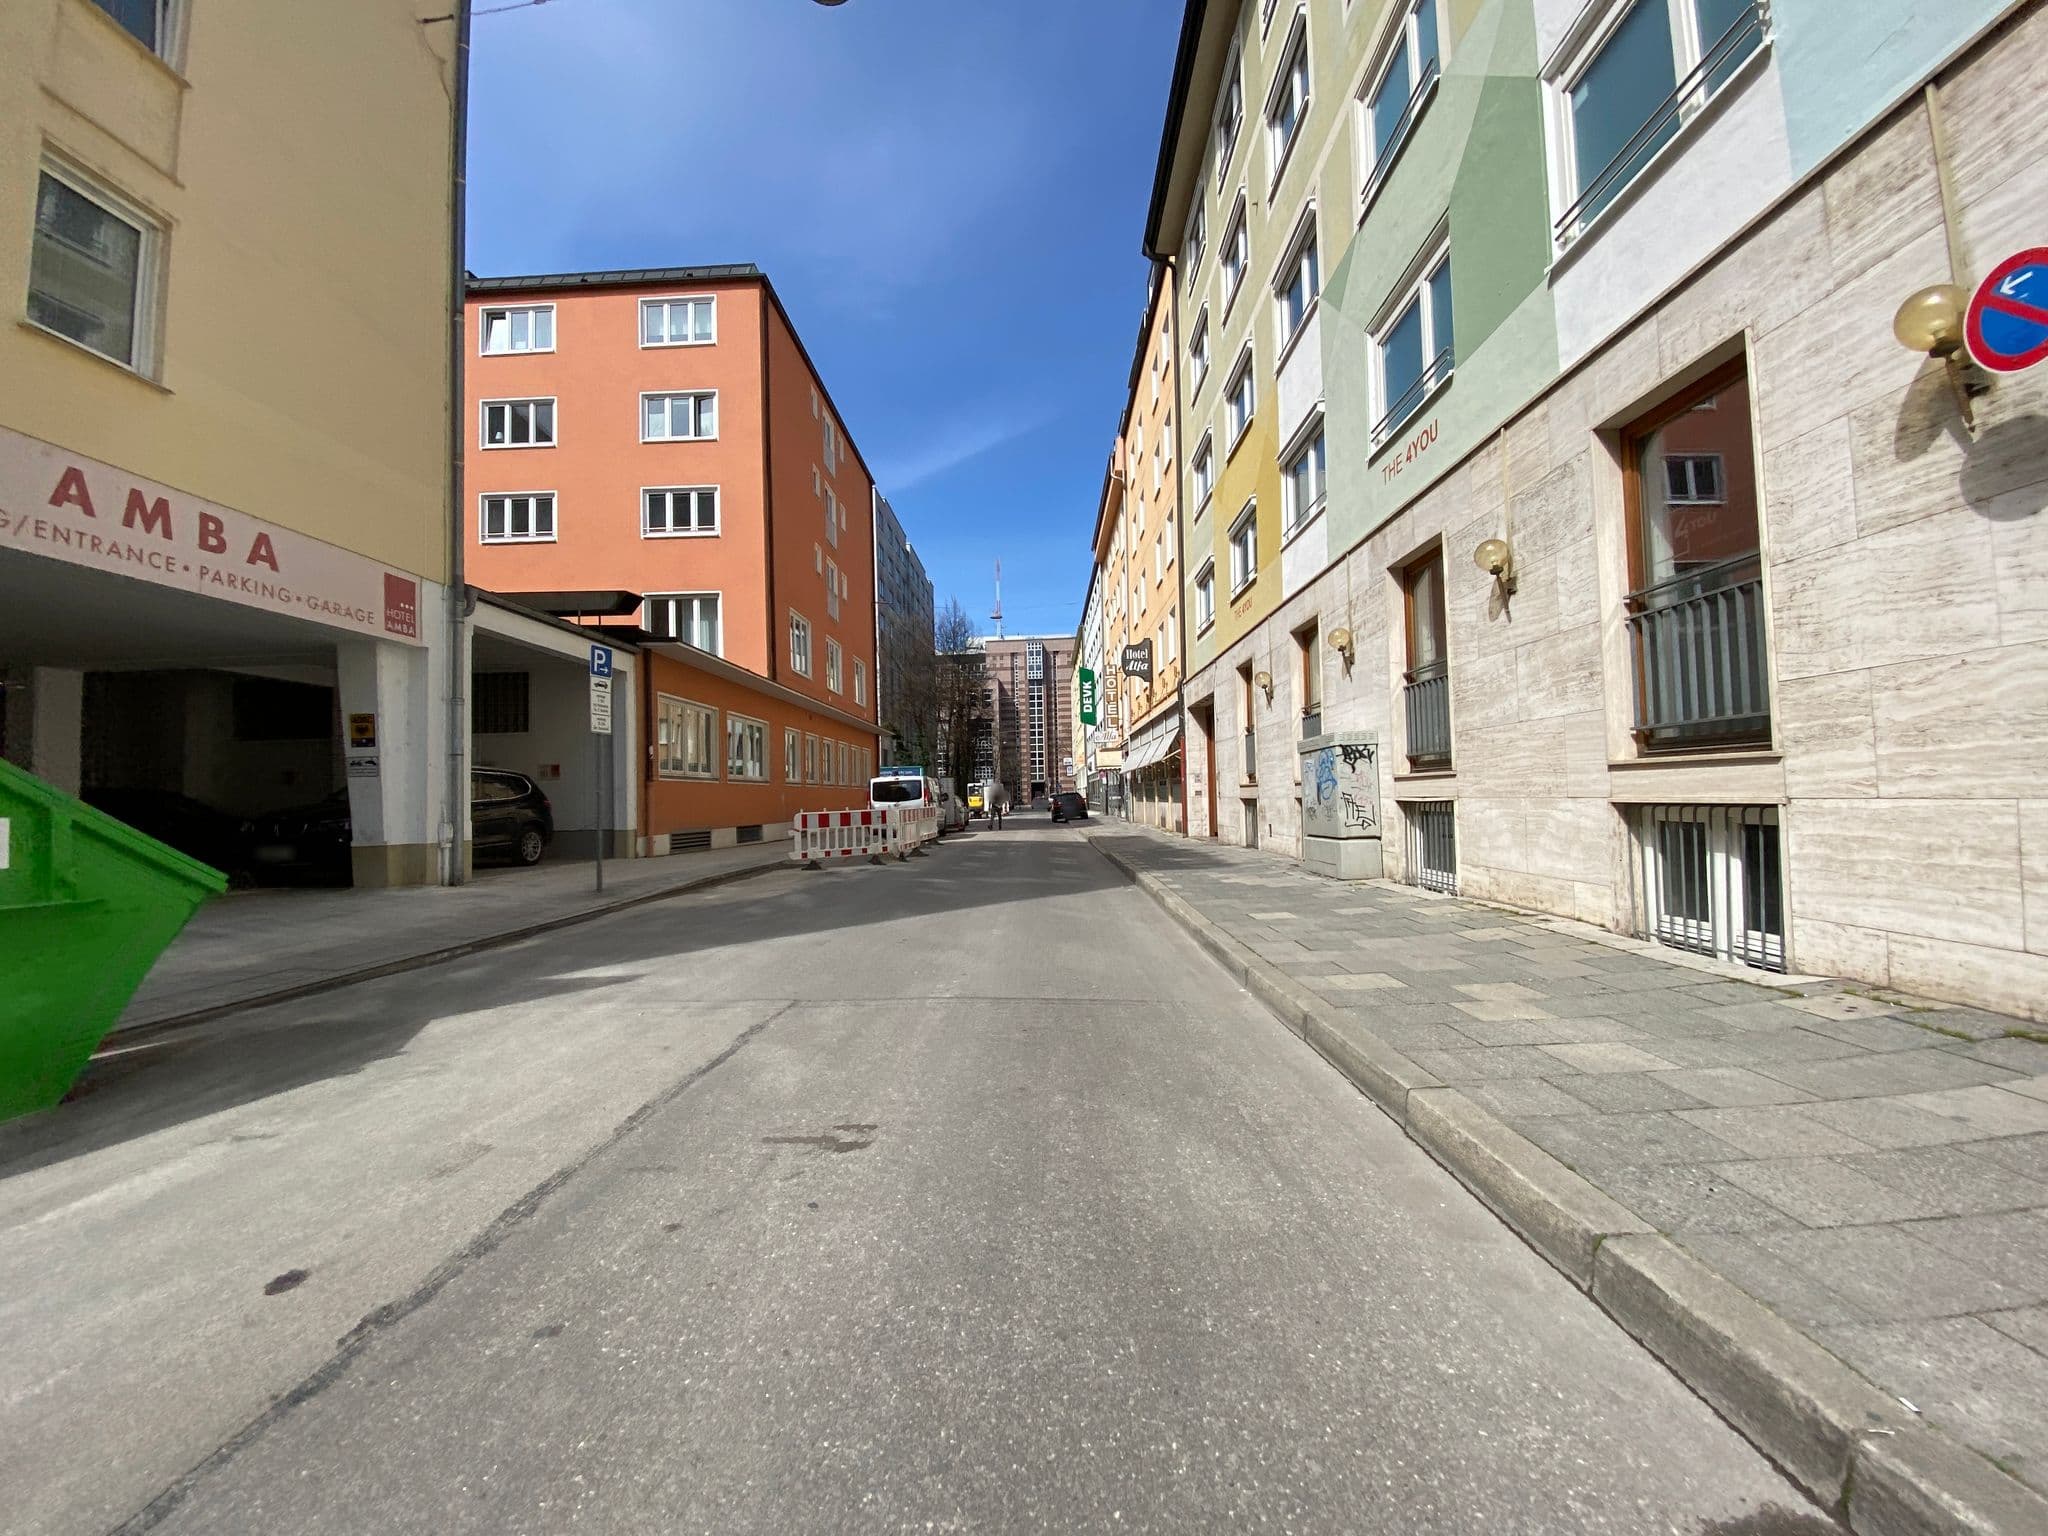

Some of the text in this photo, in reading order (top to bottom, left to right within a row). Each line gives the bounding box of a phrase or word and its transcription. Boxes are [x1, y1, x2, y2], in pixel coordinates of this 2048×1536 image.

[1381, 417, 1438, 486] THE 4YOU
[48, 465, 280, 573] AMBA
[199, 565, 292, 603] PARKING
[306, 595, 376, 625] GARAGE
[386, 620, 416, 636] AMBA
[387, 607, 415, 624] HOTEL
[594, 649, 606, 672] P
[1125, 648, 1149, 660] Hotel
[1125, 660, 1149, 672] Alfa
[1082, 680, 1093, 713] DEVK
[1105, 664, 1119, 728] HOTEL
